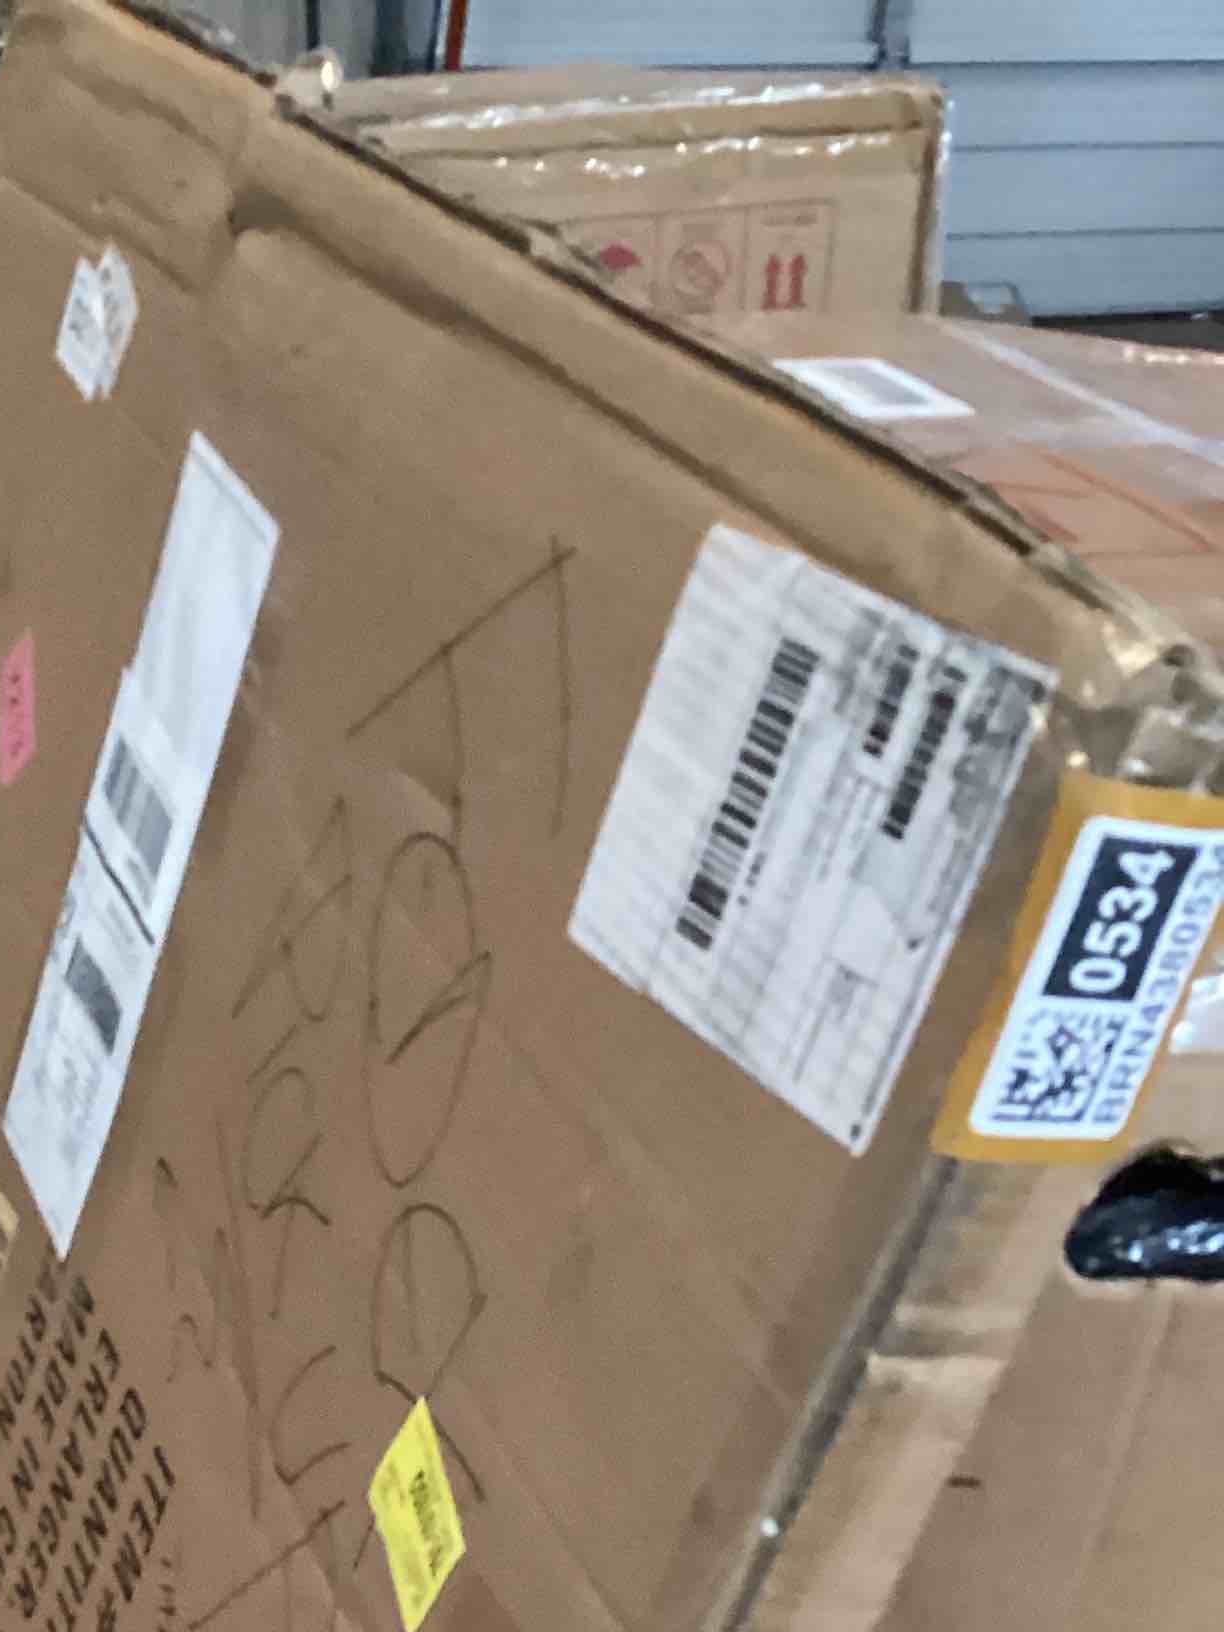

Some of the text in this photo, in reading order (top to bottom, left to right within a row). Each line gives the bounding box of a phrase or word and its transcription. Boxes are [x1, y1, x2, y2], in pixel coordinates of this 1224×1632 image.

[1068, 848, 1177, 993] 0534
[34, 1274, 97, 1443] MADE
[10, 1436, 41, 1511] IN
